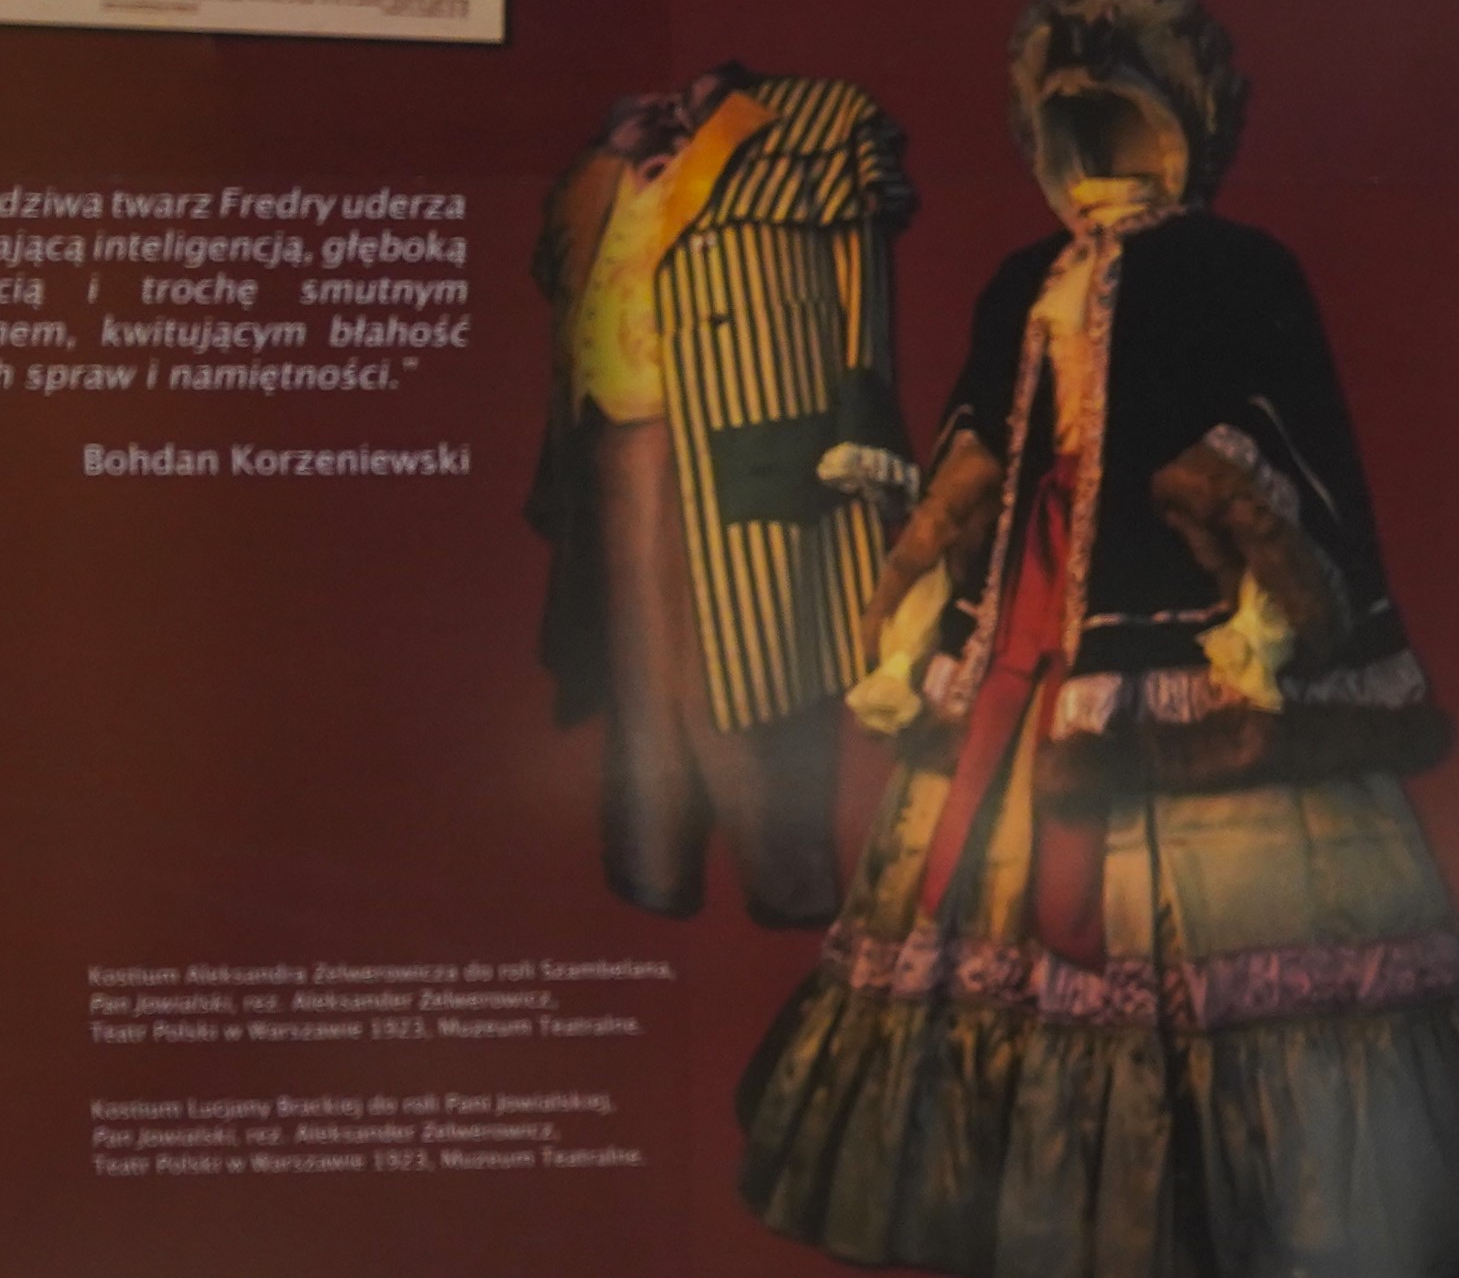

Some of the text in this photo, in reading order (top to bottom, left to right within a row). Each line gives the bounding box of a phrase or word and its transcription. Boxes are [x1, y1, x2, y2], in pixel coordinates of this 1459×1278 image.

[112, 191, 211, 218] twarz
[220, 187, 336, 223] Fredry
[342, 188, 465, 219] uderza
[322, 230, 466, 268] głęboką
[88, 278, 98, 303] i
[142, 273, 258, 307] trochę
[302, 278, 468, 310] smutnym
[101, 315, 306, 354] kwitującym
[329, 316, 468, 347] błahość
[27, 364, 136, 395] spraw
[146, 363, 157, 389] i
[84, 444, 470, 475] Bohdan Korzeniewski
